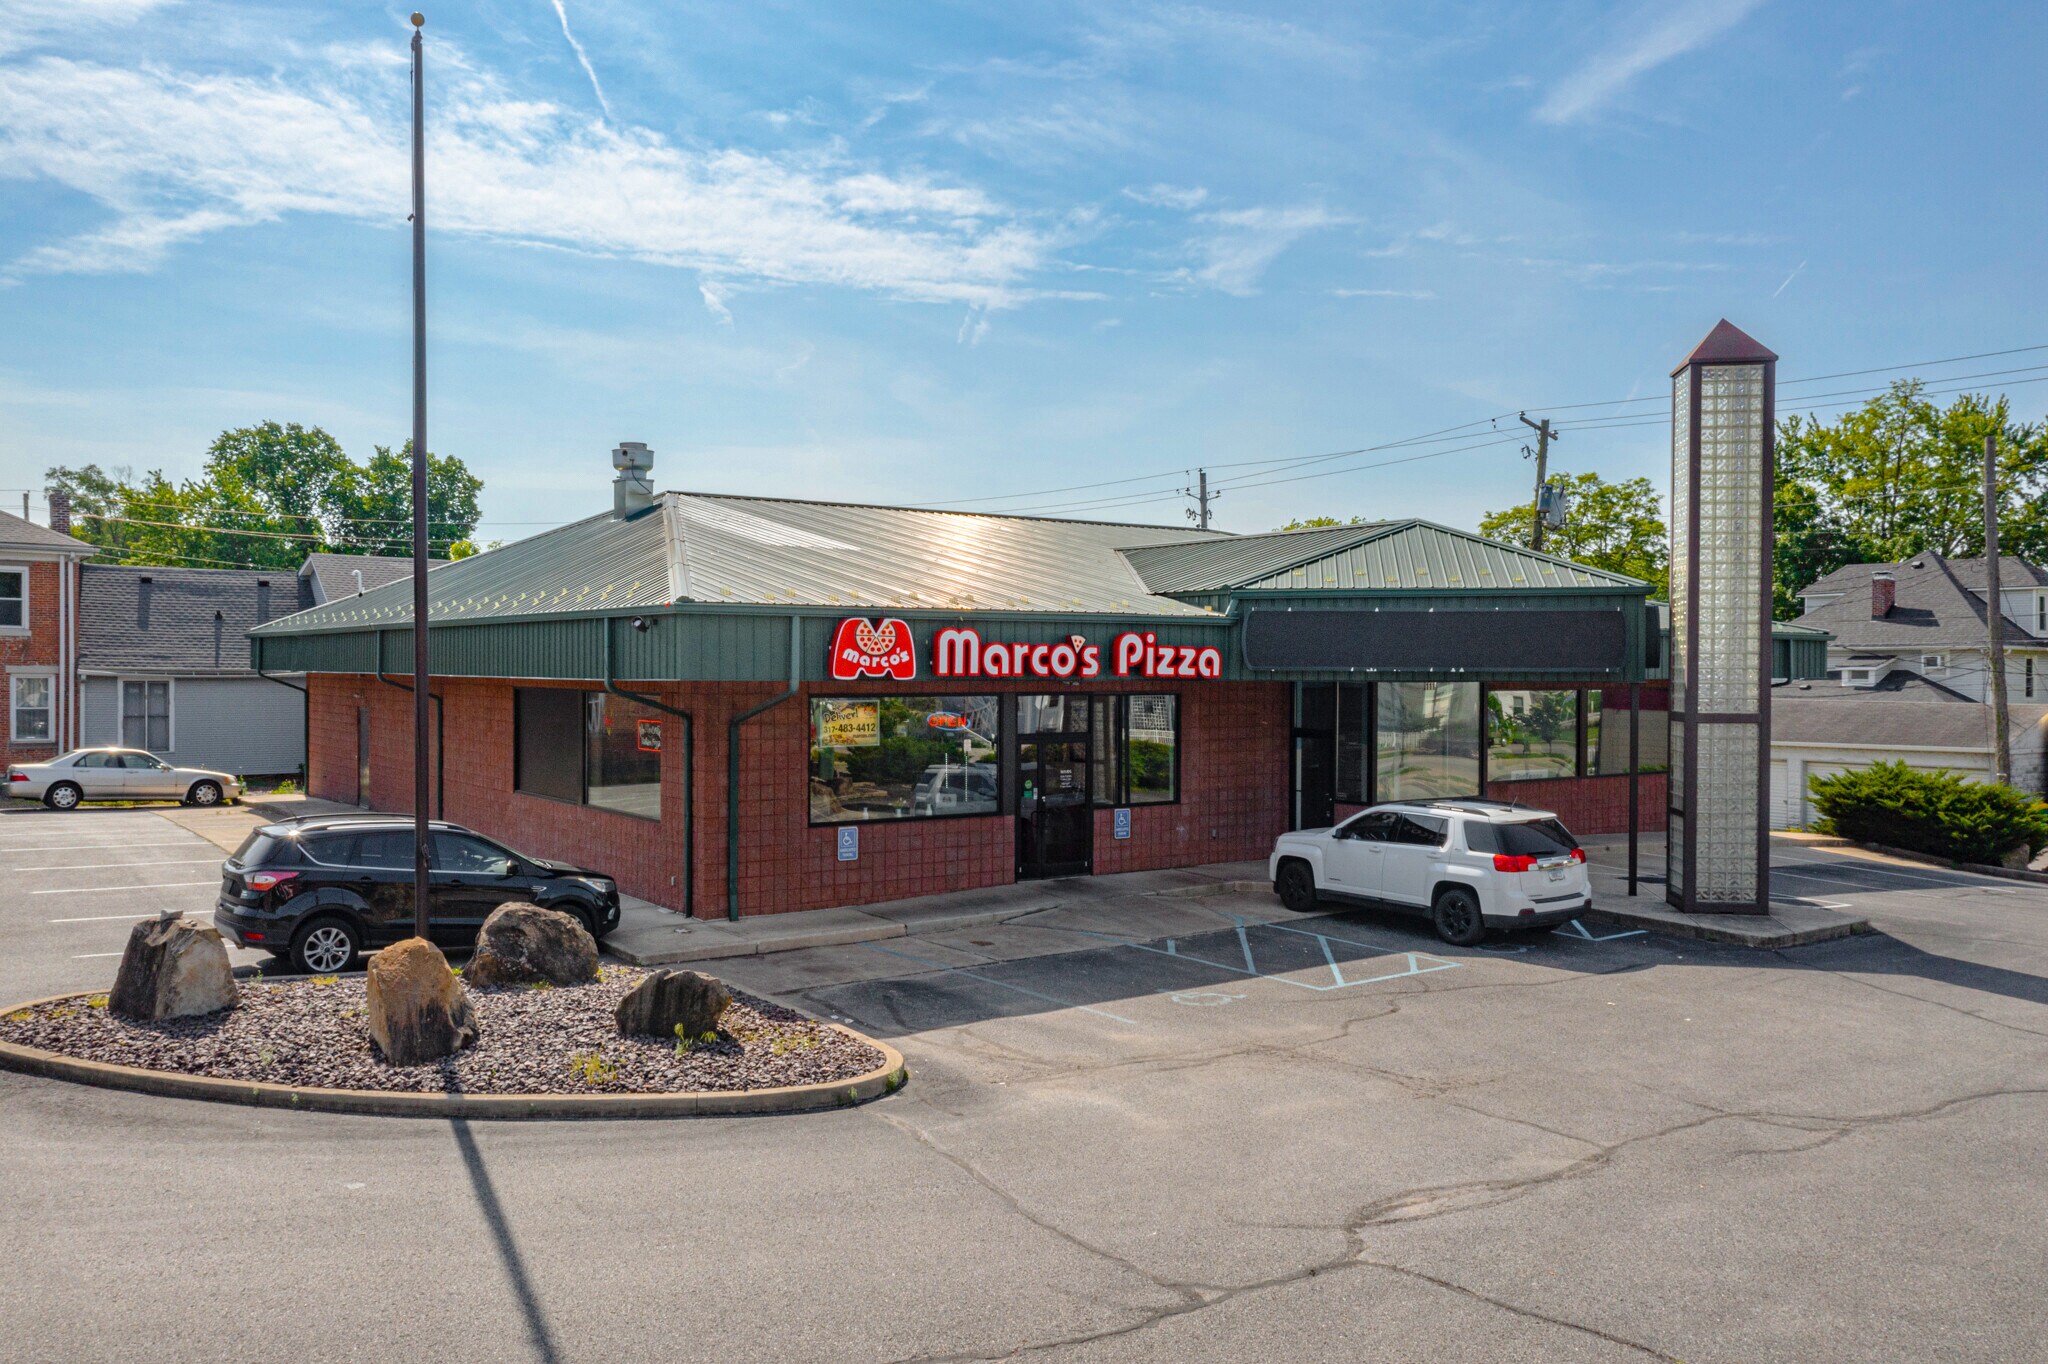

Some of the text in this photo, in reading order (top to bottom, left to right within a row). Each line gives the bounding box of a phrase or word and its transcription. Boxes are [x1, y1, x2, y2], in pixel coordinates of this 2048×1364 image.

[934, 627, 1222, 678] Marco's Pizza
[928, 715, 967, 727] OPEN
[823, 722, 876, 734] 317-483-4412
